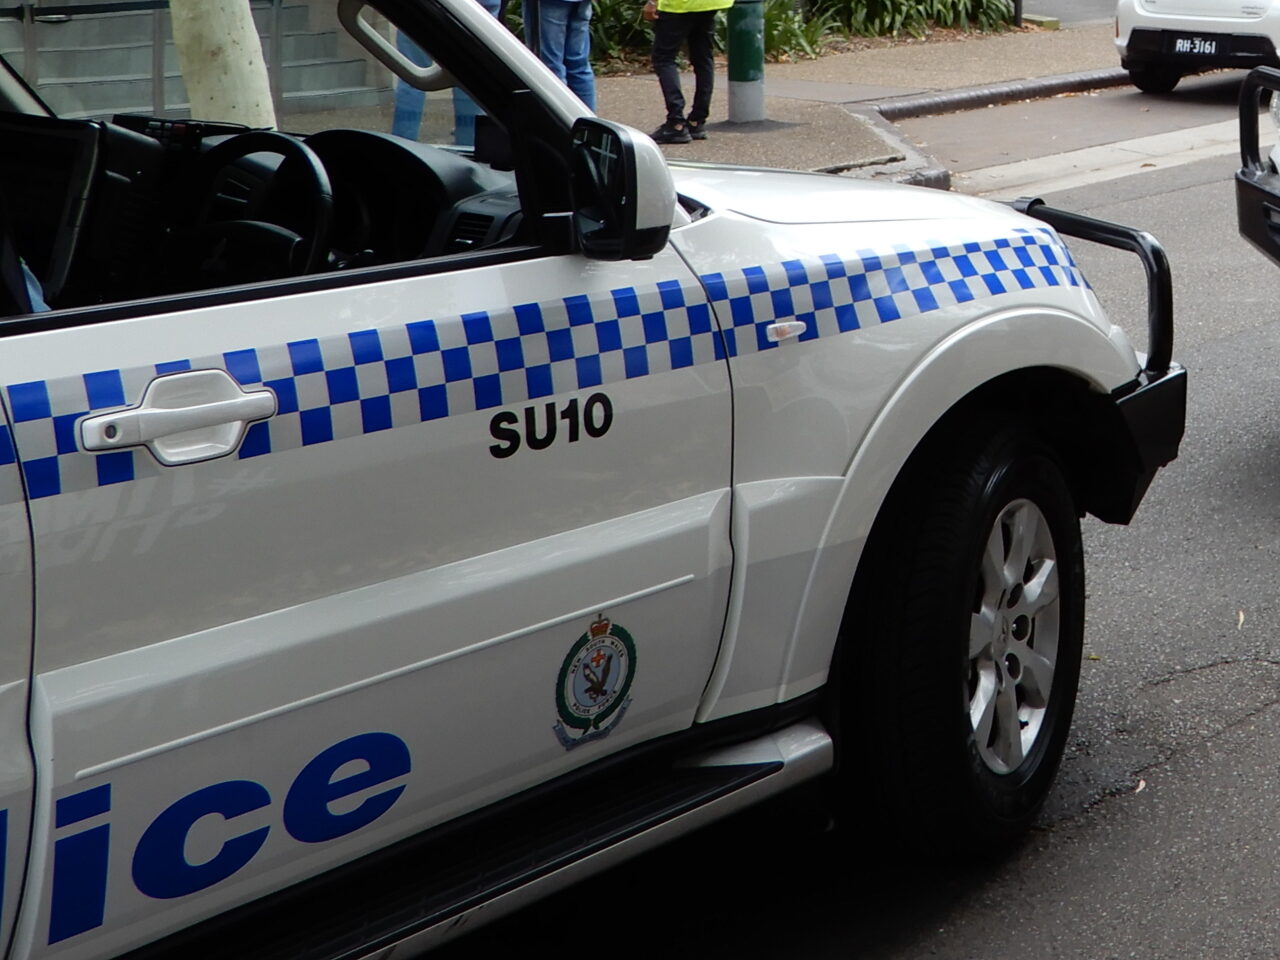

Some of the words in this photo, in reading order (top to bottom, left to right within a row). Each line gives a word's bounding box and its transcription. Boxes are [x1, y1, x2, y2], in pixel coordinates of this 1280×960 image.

[1175, 38, 1216, 54] RH-3161
[488, 392, 614, 460] SU10
[0, 732, 412, 946] ice
